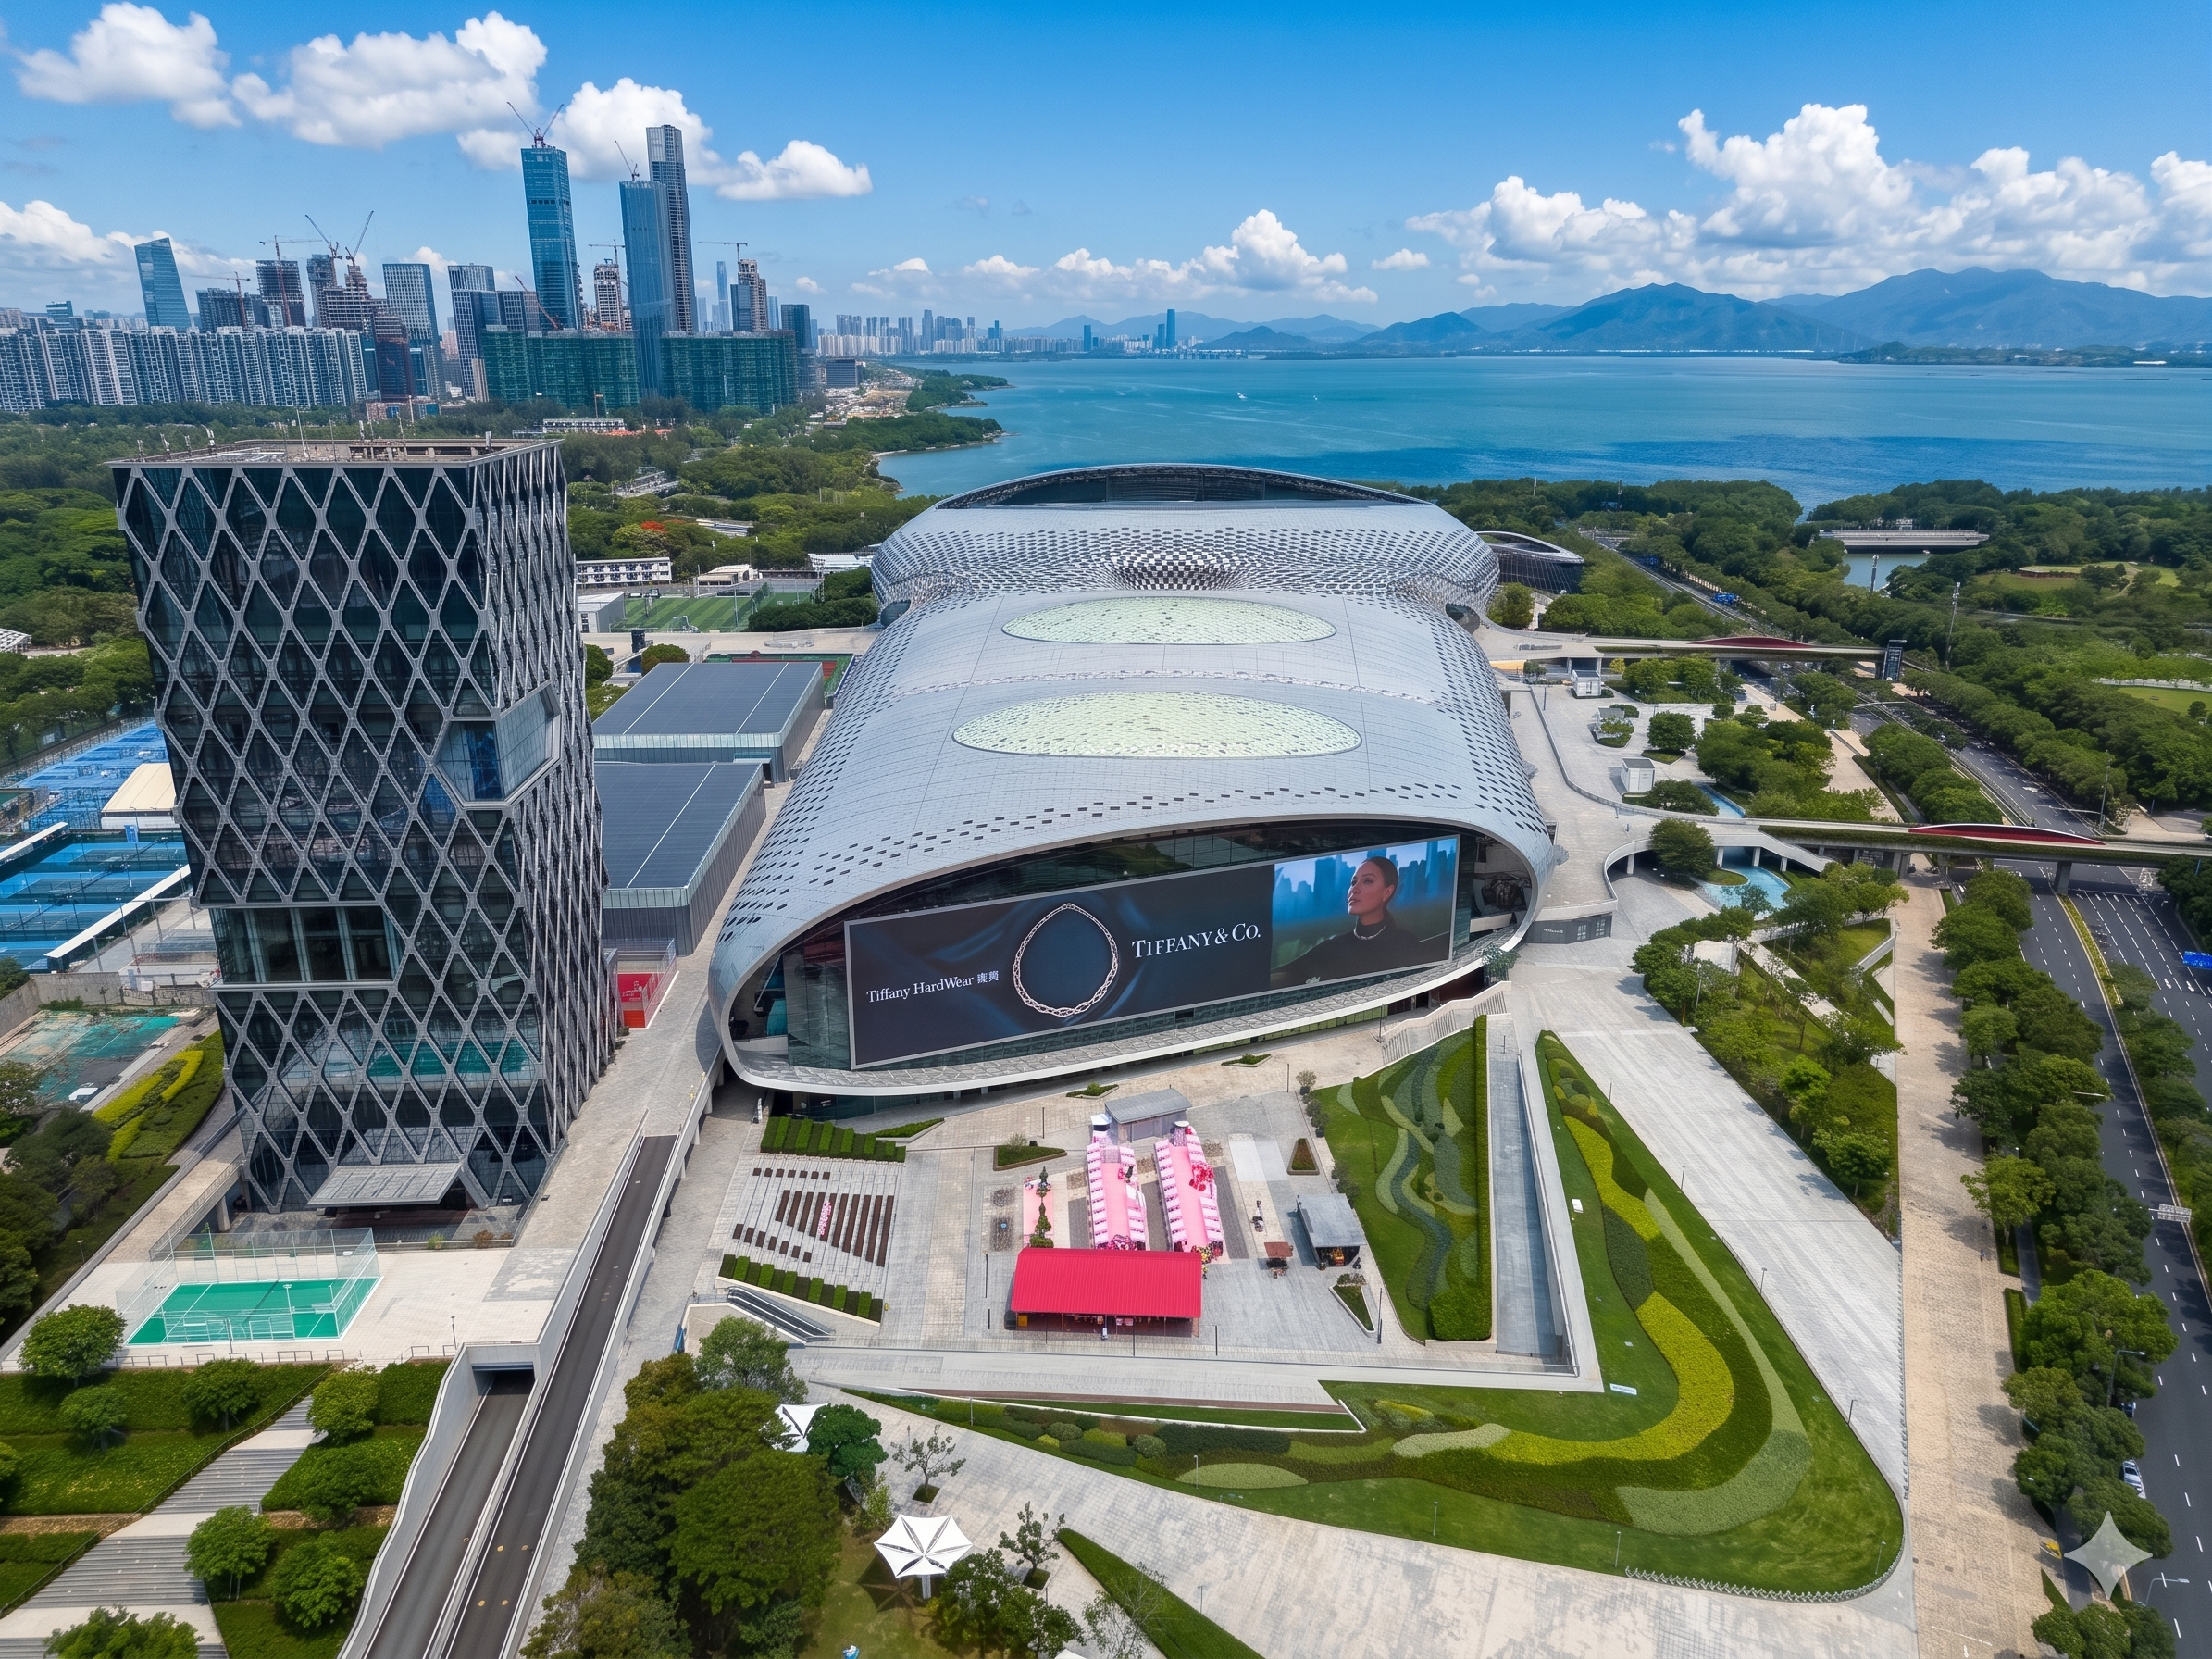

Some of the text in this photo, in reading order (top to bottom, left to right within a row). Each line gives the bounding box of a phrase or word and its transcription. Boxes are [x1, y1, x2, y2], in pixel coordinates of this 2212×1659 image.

[1131, 930, 1213, 958] TIFFANY
[866, 987, 911, 1003] Tiffany
[913, 976, 975, 995] HardWear
